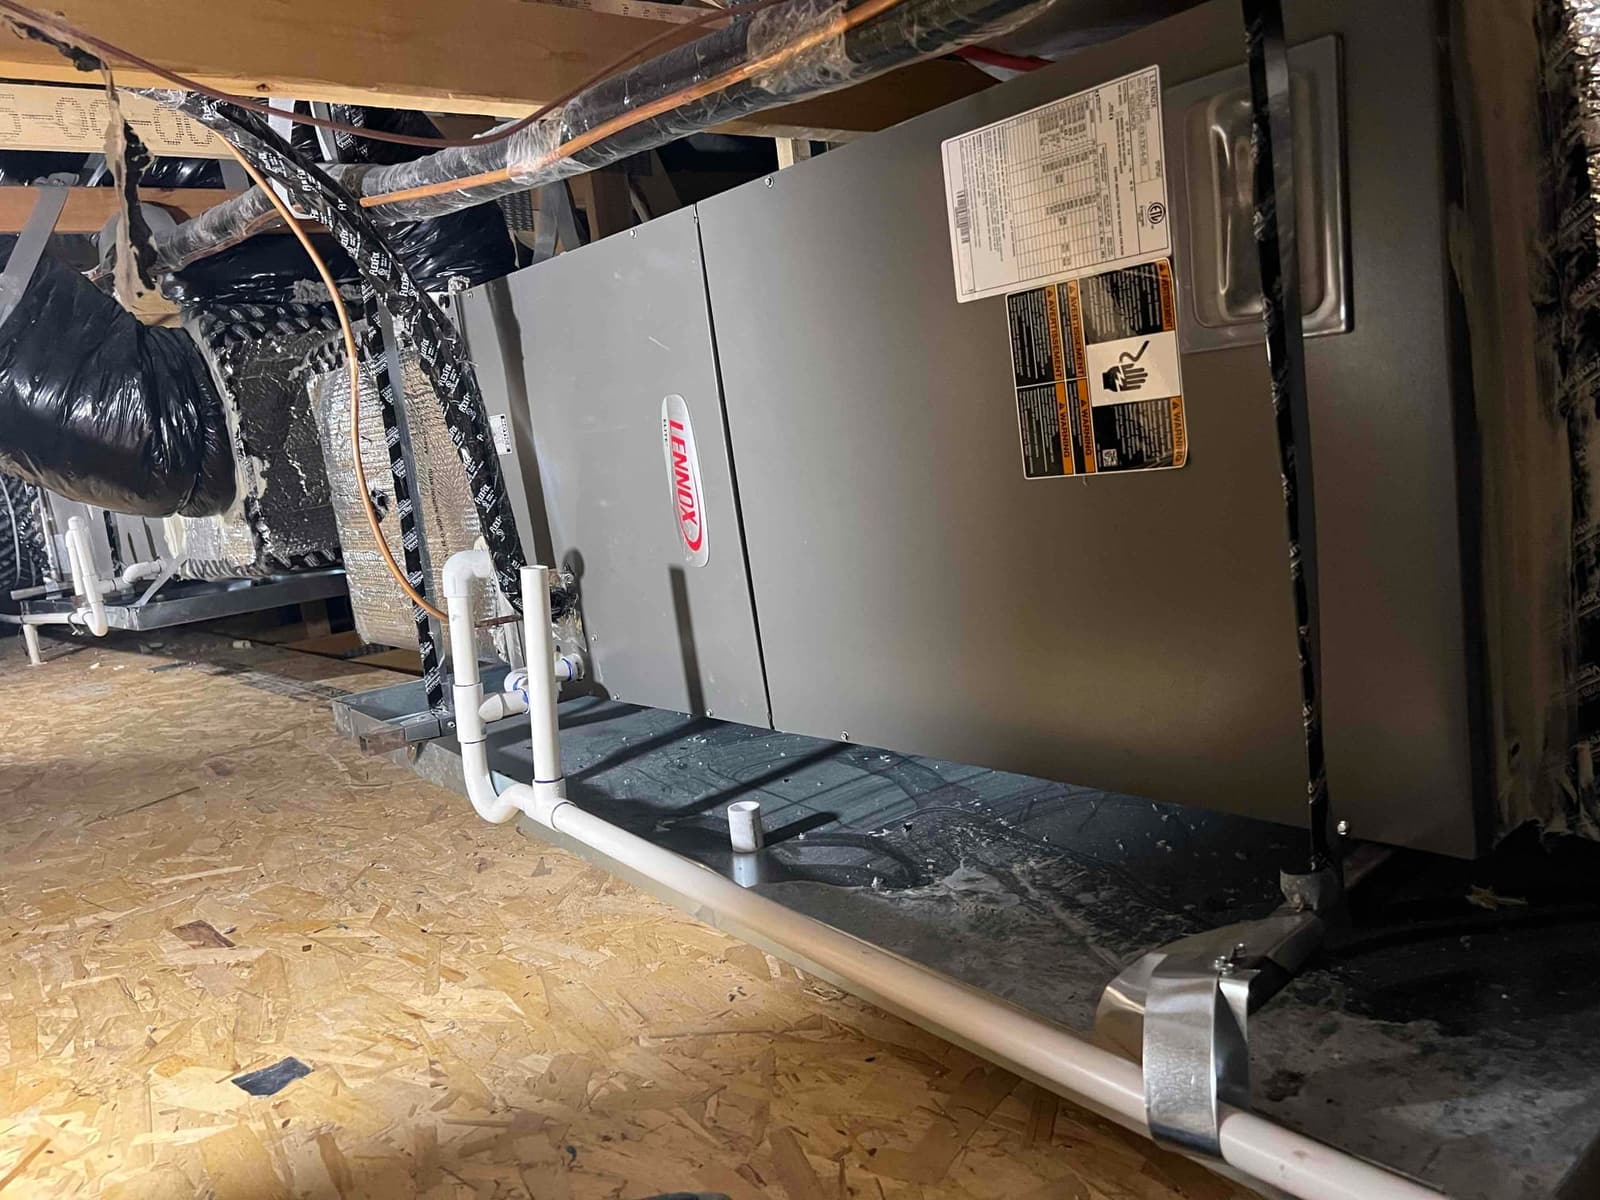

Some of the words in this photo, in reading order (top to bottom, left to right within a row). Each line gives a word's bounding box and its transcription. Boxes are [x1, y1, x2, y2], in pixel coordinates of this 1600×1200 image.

[1048, 300, 1062, 377] AVERTISSEMENT
[1060, 413, 1070, 458] WARNING
[1081, 409, 1092, 457] WARNING
[669, 418, 697, 526] LENNOX
